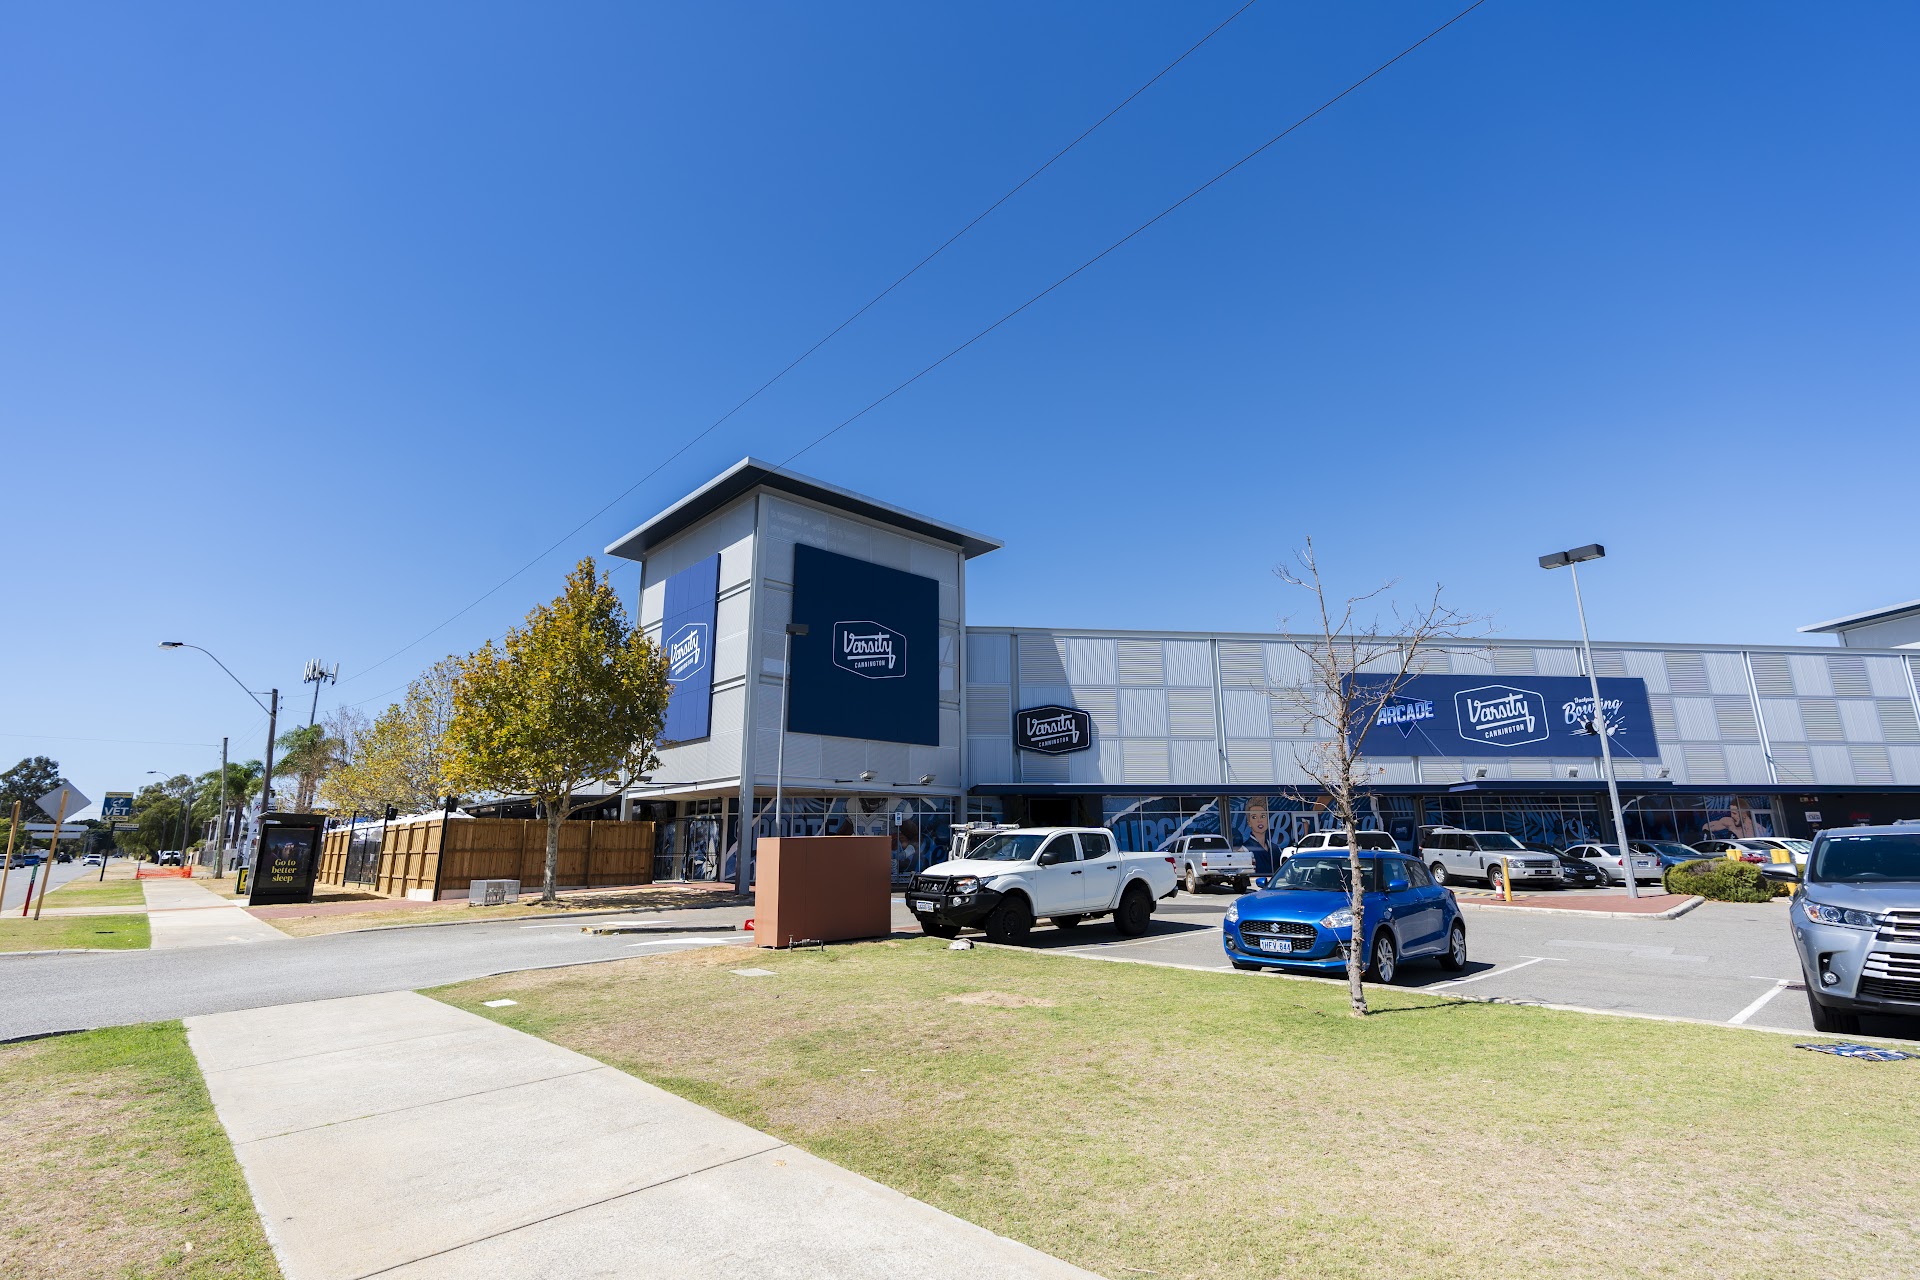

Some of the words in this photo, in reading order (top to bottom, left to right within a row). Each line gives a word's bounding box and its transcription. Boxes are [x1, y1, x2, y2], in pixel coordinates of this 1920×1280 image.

[670, 629, 700, 670] Varsity
[843, 630, 896, 669] Varsity
[854, 660, 886, 669] CANNINGTON
[1376, 700, 1436, 727] ARCADE
[1467, 692, 1535, 733] Varsity
[1562, 698, 1624, 725] Bowing
[1026, 713, 1080, 744] Varsity
[1484, 723, 1525, 739] CANNINGTON
[104, 807, 129, 816] VET
[271, 866, 297, 874] better
[275, 858, 286, 866] Go
[272, 874, 293, 883] sleep
